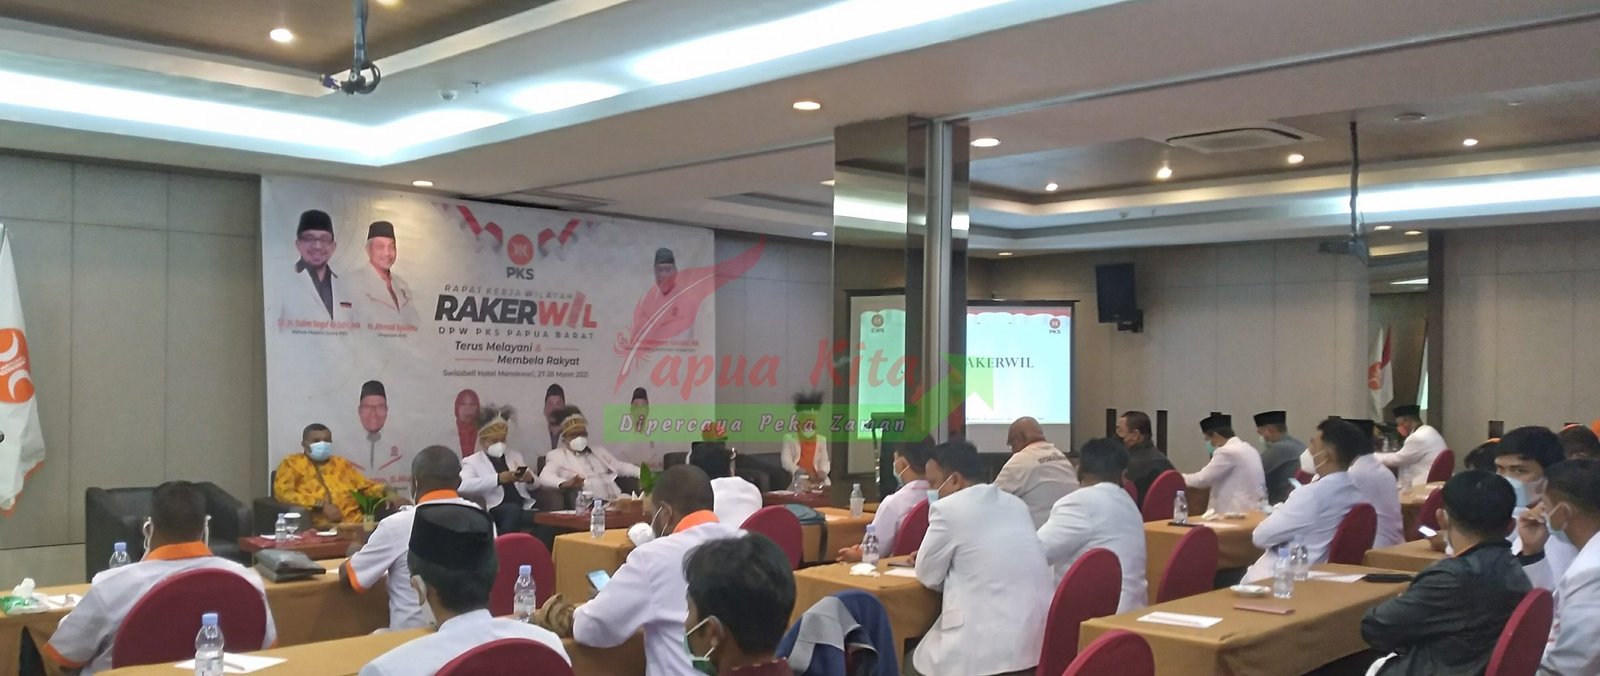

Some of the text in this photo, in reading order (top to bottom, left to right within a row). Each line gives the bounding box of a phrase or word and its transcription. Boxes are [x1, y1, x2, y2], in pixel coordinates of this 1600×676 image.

[506, 266, 535, 281] PKS
[444, 284, 573, 301] RAPAT KERJA WILAYAH
[434, 291, 598, 329] RAKERWIL
[438, 326, 595, 339] DPW PKS PAPUA BARAT
[455, 340, 484, 351] Terus
[485, 342, 533, 354] Melayani
[496, 355, 580, 368] Membela Rakyat
[966, 356, 1034, 369] AKERWIL
